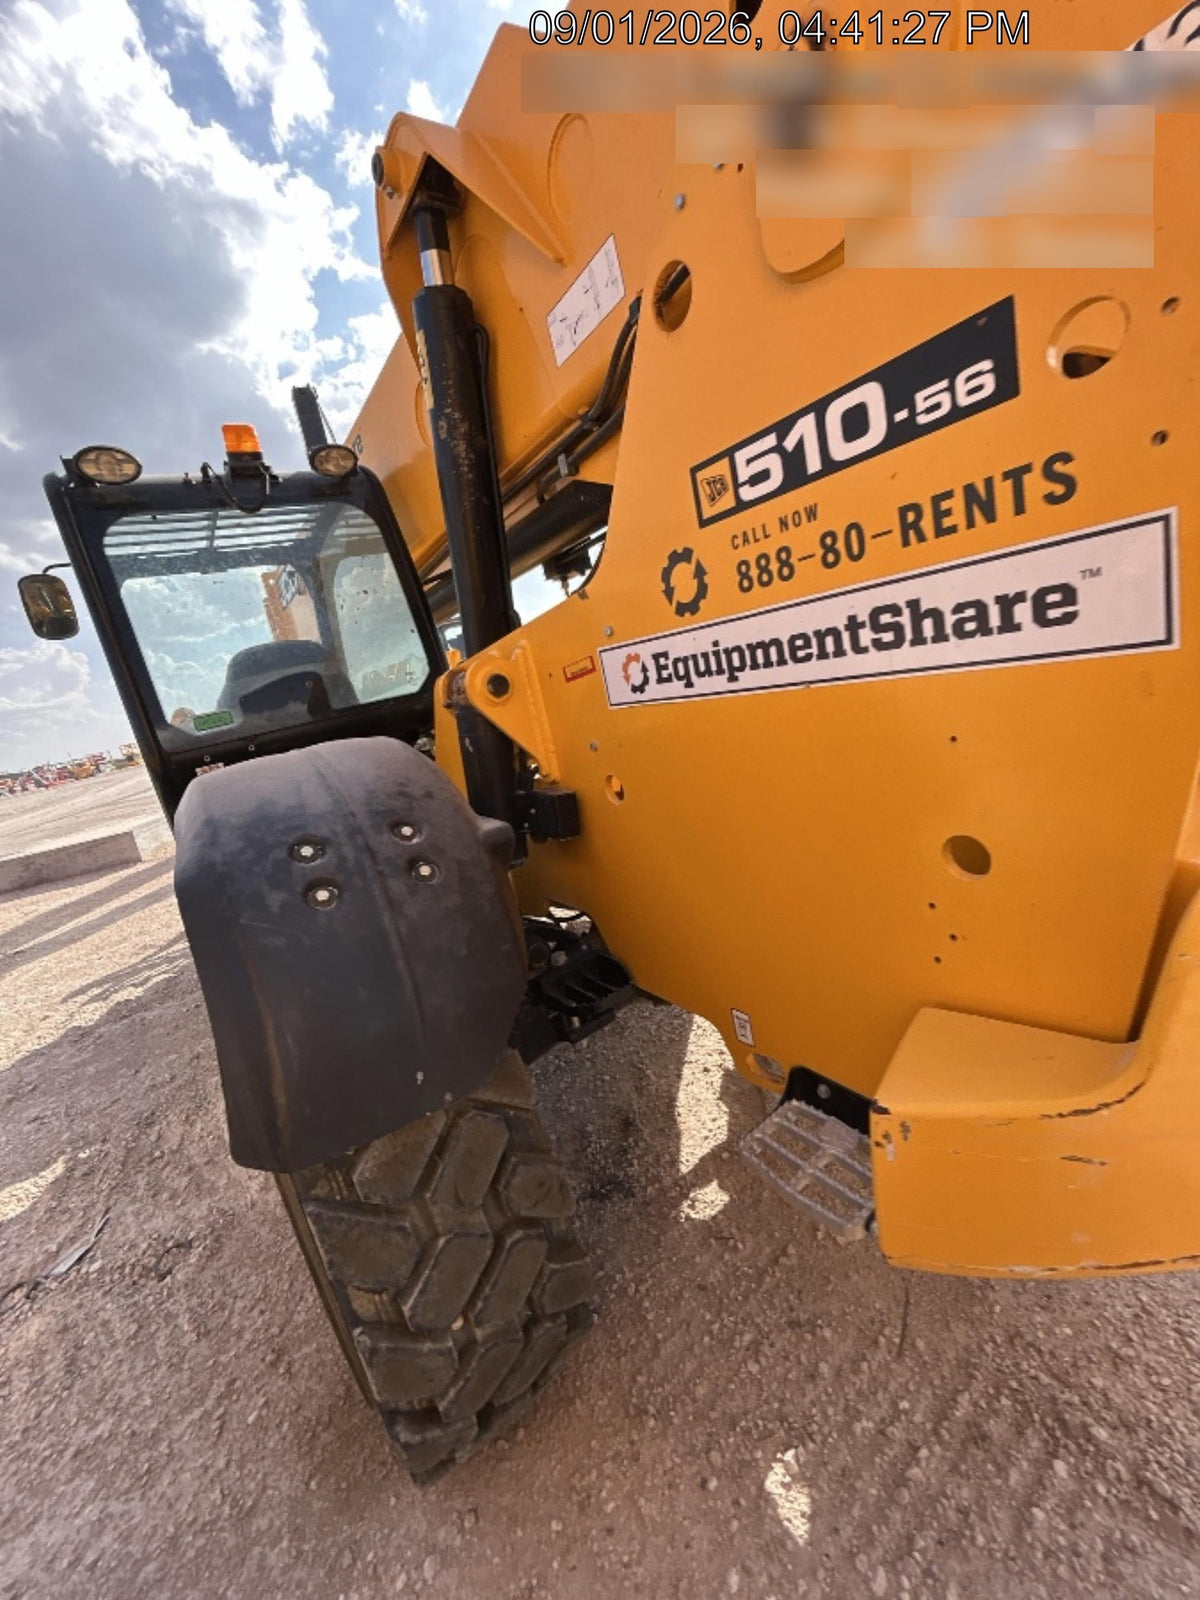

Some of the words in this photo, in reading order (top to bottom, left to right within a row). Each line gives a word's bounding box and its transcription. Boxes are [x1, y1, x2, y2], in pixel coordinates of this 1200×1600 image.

[734, 357, 998, 504] 510-56
[730, 523, 771, 550] CALL
[778, 503, 820, 534] NOW
[735, 451, 1077, 594] 888-80-RENTS
[652, 581, 1079, 687] EquipmentShare
